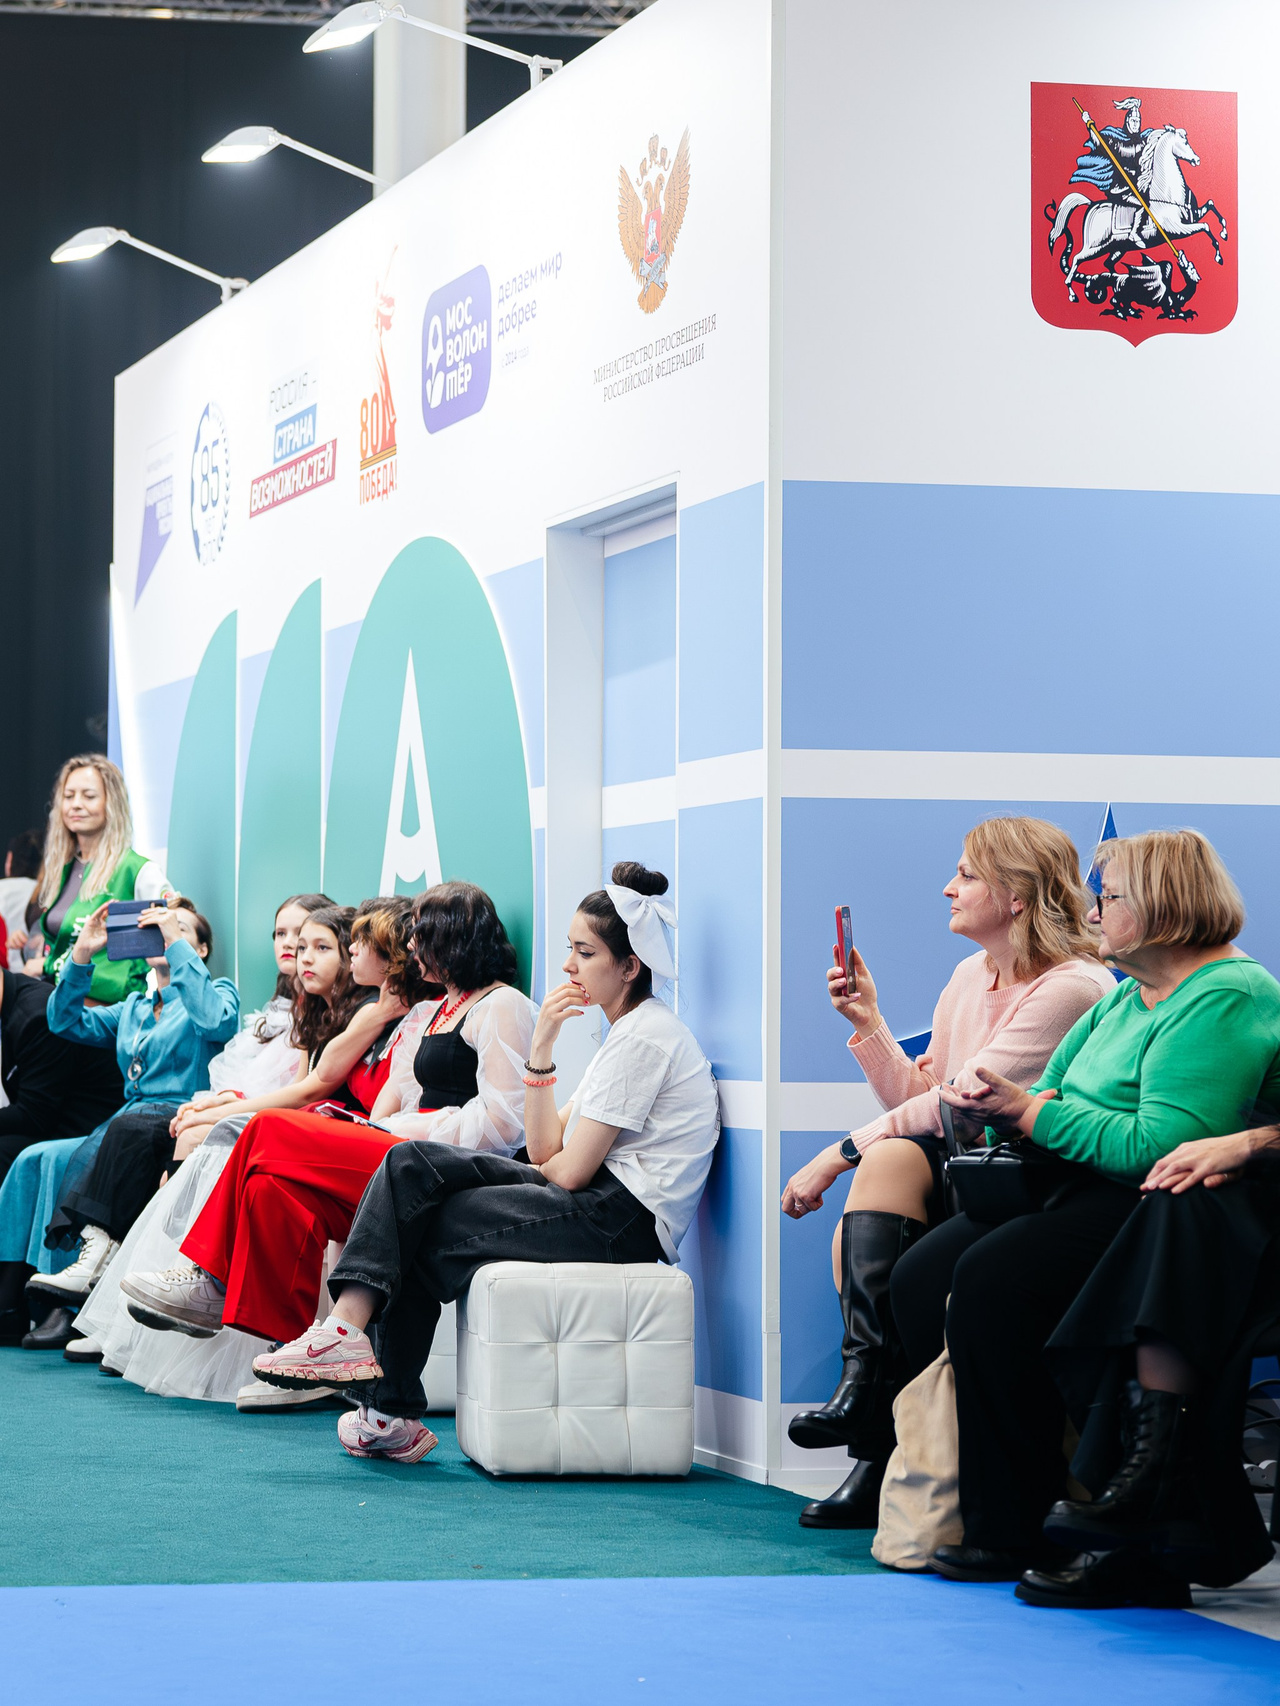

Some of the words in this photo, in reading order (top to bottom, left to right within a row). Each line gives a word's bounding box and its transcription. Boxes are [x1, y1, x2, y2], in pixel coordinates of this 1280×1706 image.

[498, 264, 538, 309] делаем
[540, 251, 563, 280] мир
[445, 296, 473, 332] МОС
[497, 299, 538, 342] добрее
[445, 319, 487, 368] ВОЛОН
[593, 343, 654, 385] МИНИСТЕРСТВО
[655, 313, 717, 357] ПРОСВЕЩЕНИЯ
[603, 364, 654, 403] РОССИЙСКОЙ
[655, 343, 705, 379] ФЕДЕРАЦИИ
[275, 414, 315, 459] СТРАНА
[360, 392, 380, 460] 80
[200, 438, 220, 513] 85
[251, 442, 334, 513] ВОЗМОЖНОСТЕЙ
[359, 459, 398, 506] ПОБЕДА!
